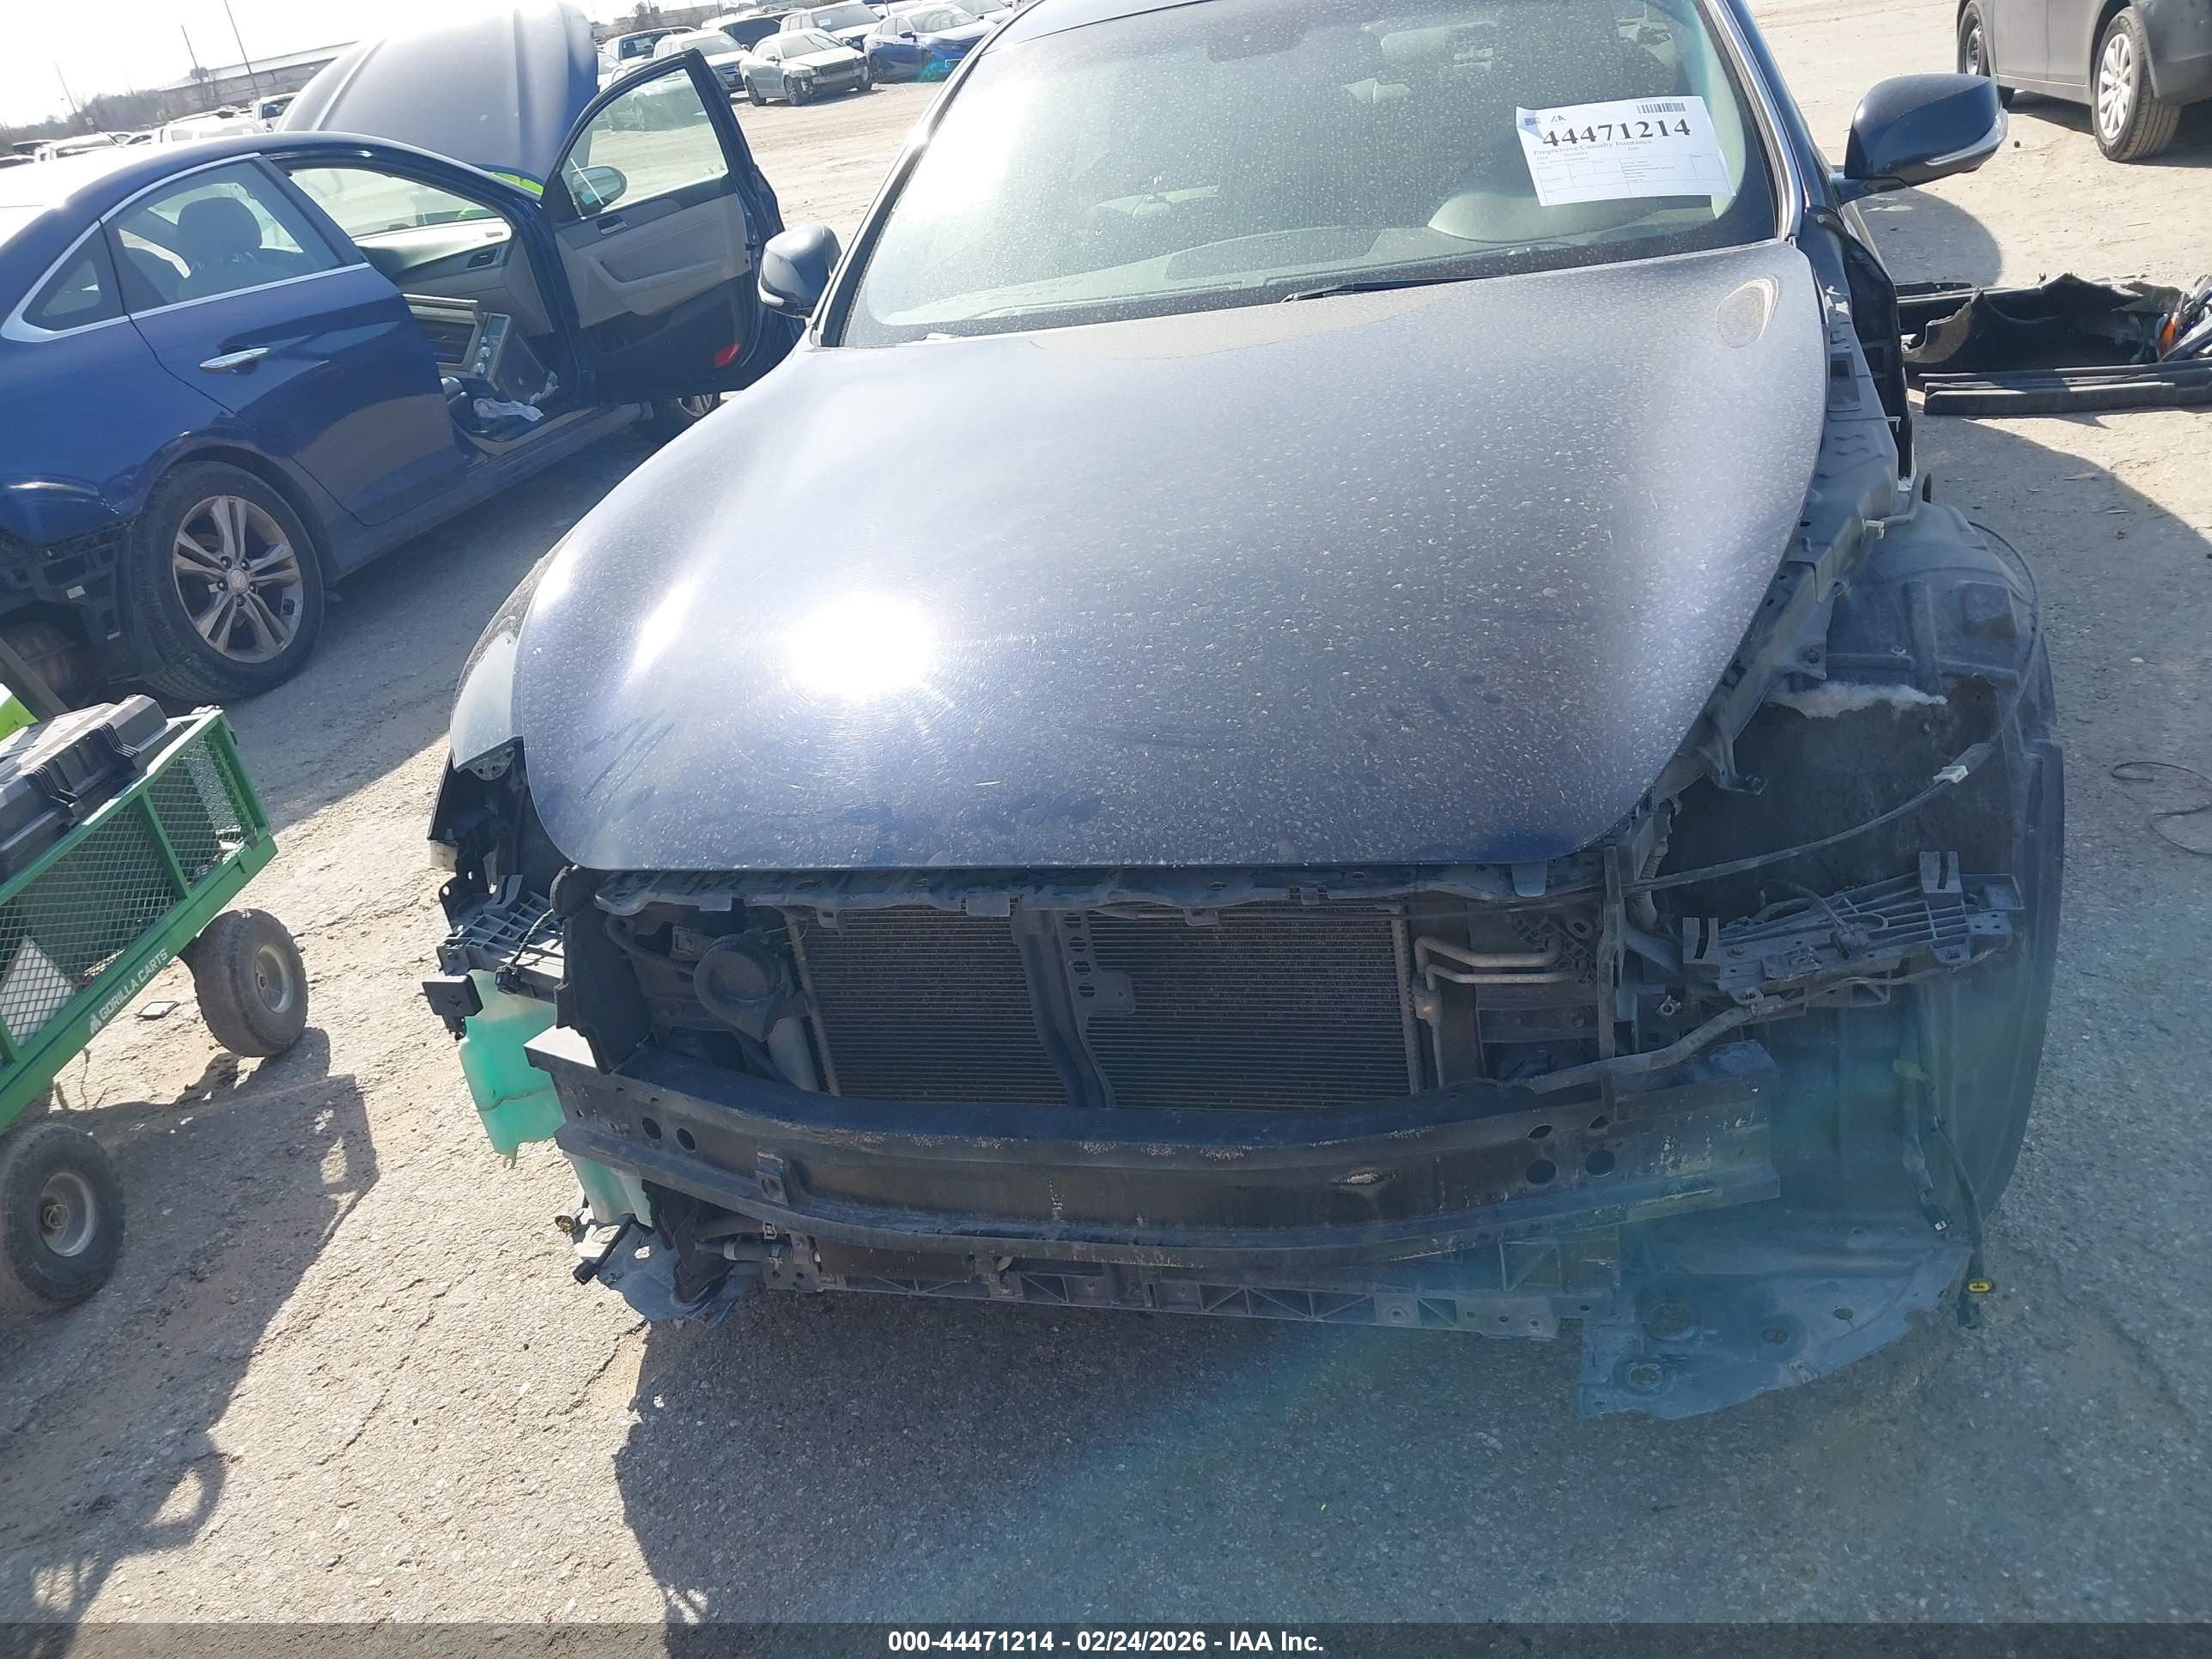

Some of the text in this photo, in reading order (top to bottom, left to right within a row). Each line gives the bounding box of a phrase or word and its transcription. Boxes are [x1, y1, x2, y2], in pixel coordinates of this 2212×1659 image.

[1542, 118, 1691, 147] 44471214
[98, 948, 168, 1021] GORILLA CARTS
